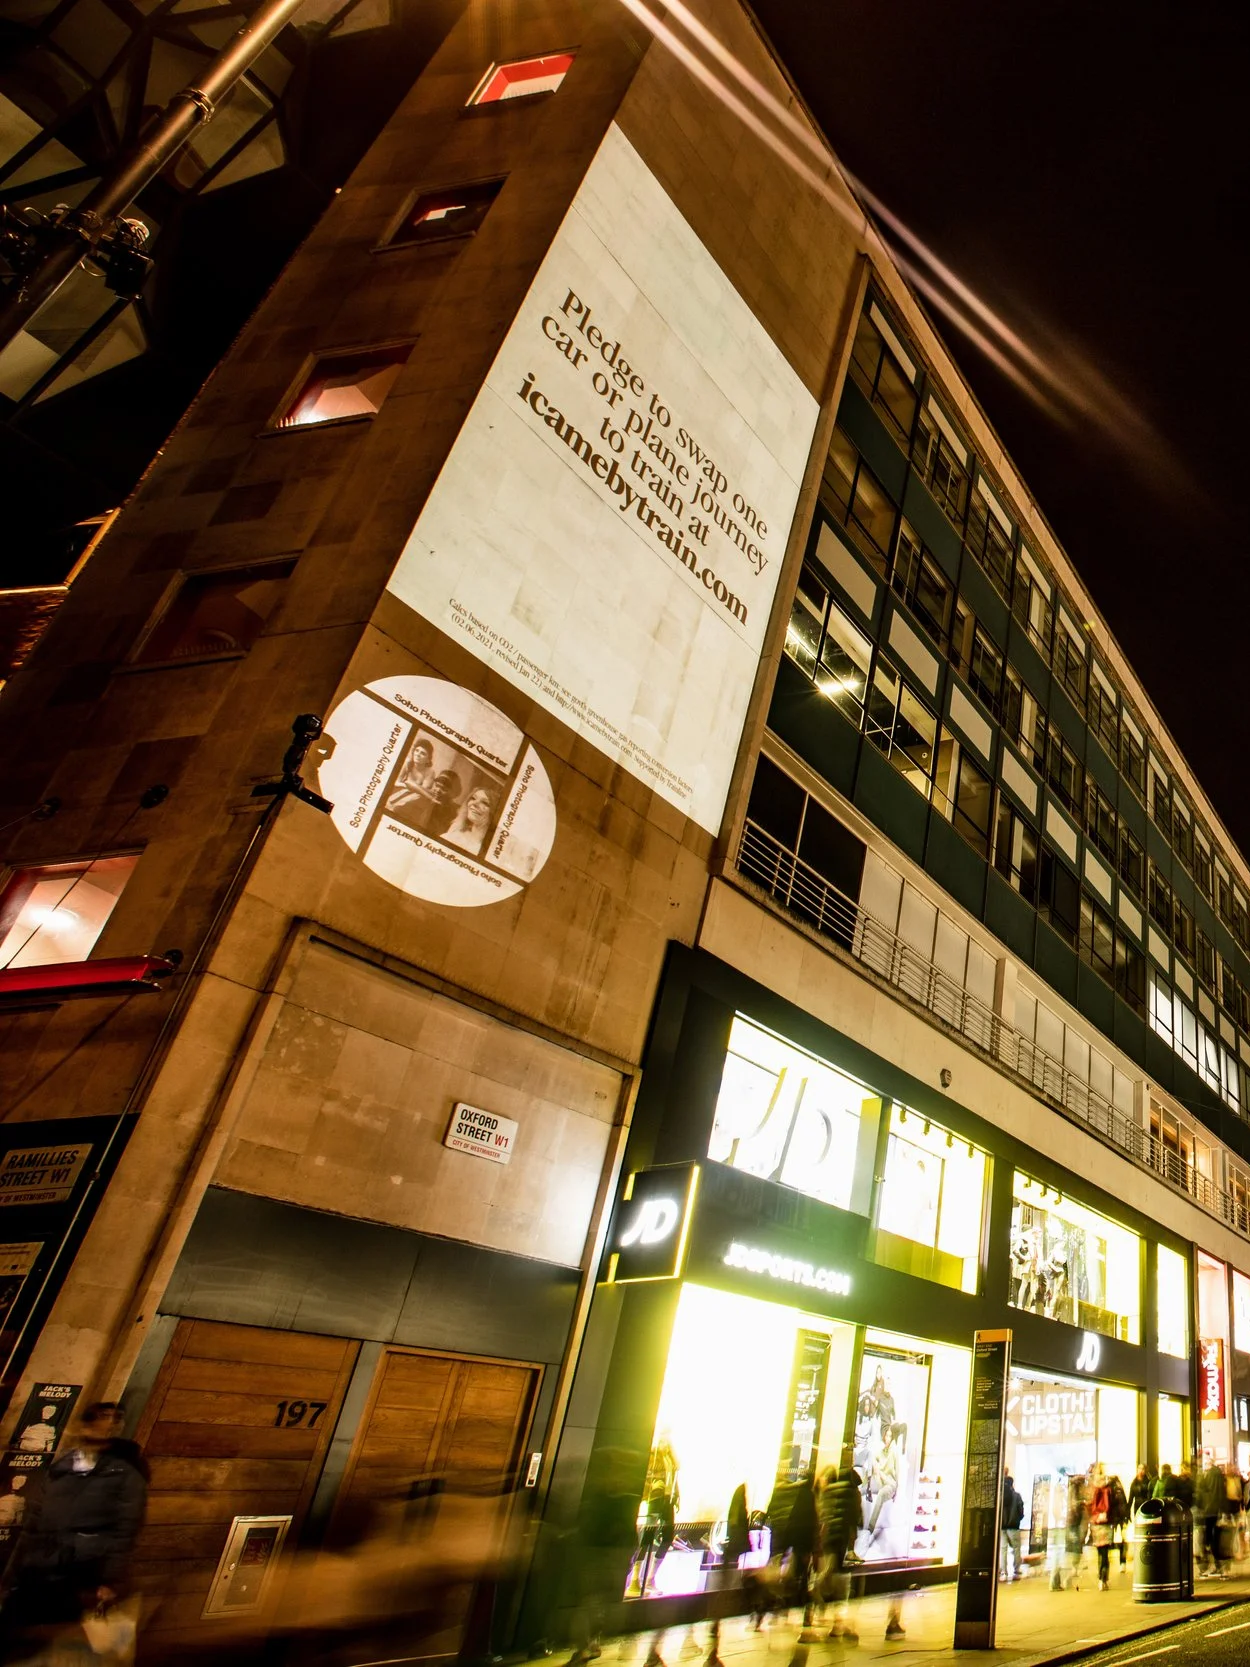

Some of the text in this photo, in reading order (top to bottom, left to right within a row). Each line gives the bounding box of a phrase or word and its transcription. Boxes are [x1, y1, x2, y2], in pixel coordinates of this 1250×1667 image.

[558, 287, 768, 541] Pledge to swap one
[541, 315, 769, 577] car or plane journey
[516, 372, 749, 627] icamebytrain.com
[599, 415, 712, 547] to train at
[449, 598, 467, 617] Calcs
[468, 612, 489, 633] based
[489, 630, 498, 641] on
[499, 636, 514, 652] CO2
[517, 653, 549, 679] passenger
[496, 648, 521, 670] revised
[518, 663, 530, 679] Jan
[542, 685, 555, 698] and
[394, 693, 508, 768] Soho Photography Quarter
[349, 723, 403, 829] Soho Photography Quarter
[492, 764, 535, 860] Soho Photography Quarter
[386, 824, 503, 888] Soho Photography Quarter
[456, 1122, 509, 1148] STREET W1
[460, 1108, 499, 1130] OXFORD
[6, 1150, 79, 1169] RAMILLIES
[463, 1141, 470, 1149] OF
[470, 1143, 501, 1158] WESTMINSTER
[0, 1167, 72, 1188] STREET W1
[620, 1197, 679, 1247] JD
[1076, 1331, 1101, 1372] JD
[43, 1385, 71, 1393] JACK'S
[274, 1400, 328, 1428] 197
[1021, 1391, 1094, 1415] CLOTHI
[1020, 1413, 1095, 1437] UPSTAI
